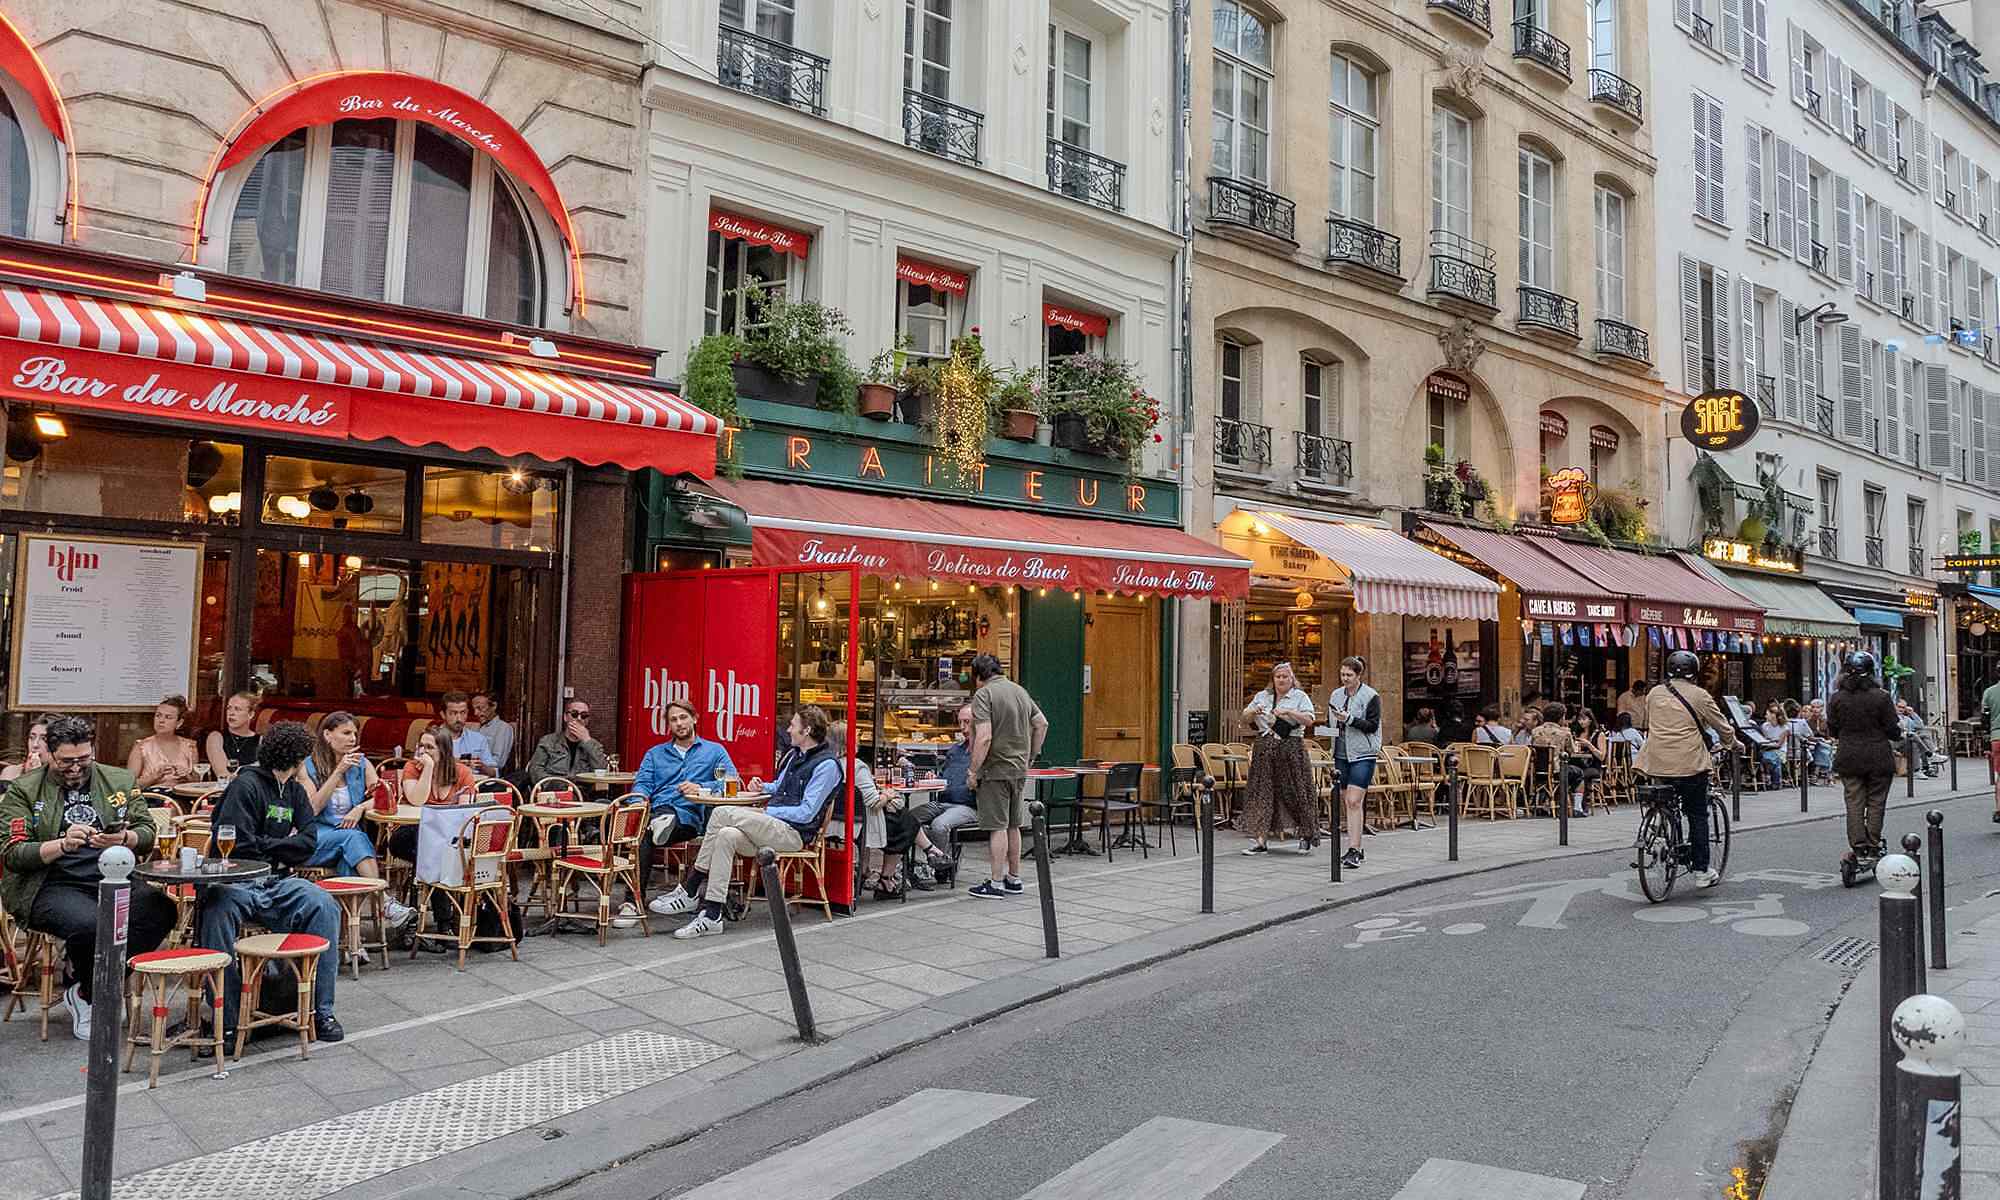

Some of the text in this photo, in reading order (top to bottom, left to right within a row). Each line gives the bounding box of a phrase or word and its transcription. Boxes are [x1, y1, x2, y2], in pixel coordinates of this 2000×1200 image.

[340, 95, 502, 151] Bar du Marché
[715, 216, 793, 247] Salon de Thé
[1048, 309, 1084, 327] Traiteur
[13, 356, 337, 426] Bar du Marché
[723, 426, 1146, 513] TRAITEUR
[799, 539, 889, 568] Traiteur
[997, 557, 1020, 577] de
[1022, 558, 1070, 580] Buci
[1112, 564, 1159, 586] Salon
[1158, 571, 1183, 588] de
[1184, 570, 1216, 592] Thé
[1529, 599, 1546, 614] CAVE
[1586, 604, 1600, 617] TAKE
[1600, 605, 1616, 617] AWAY
